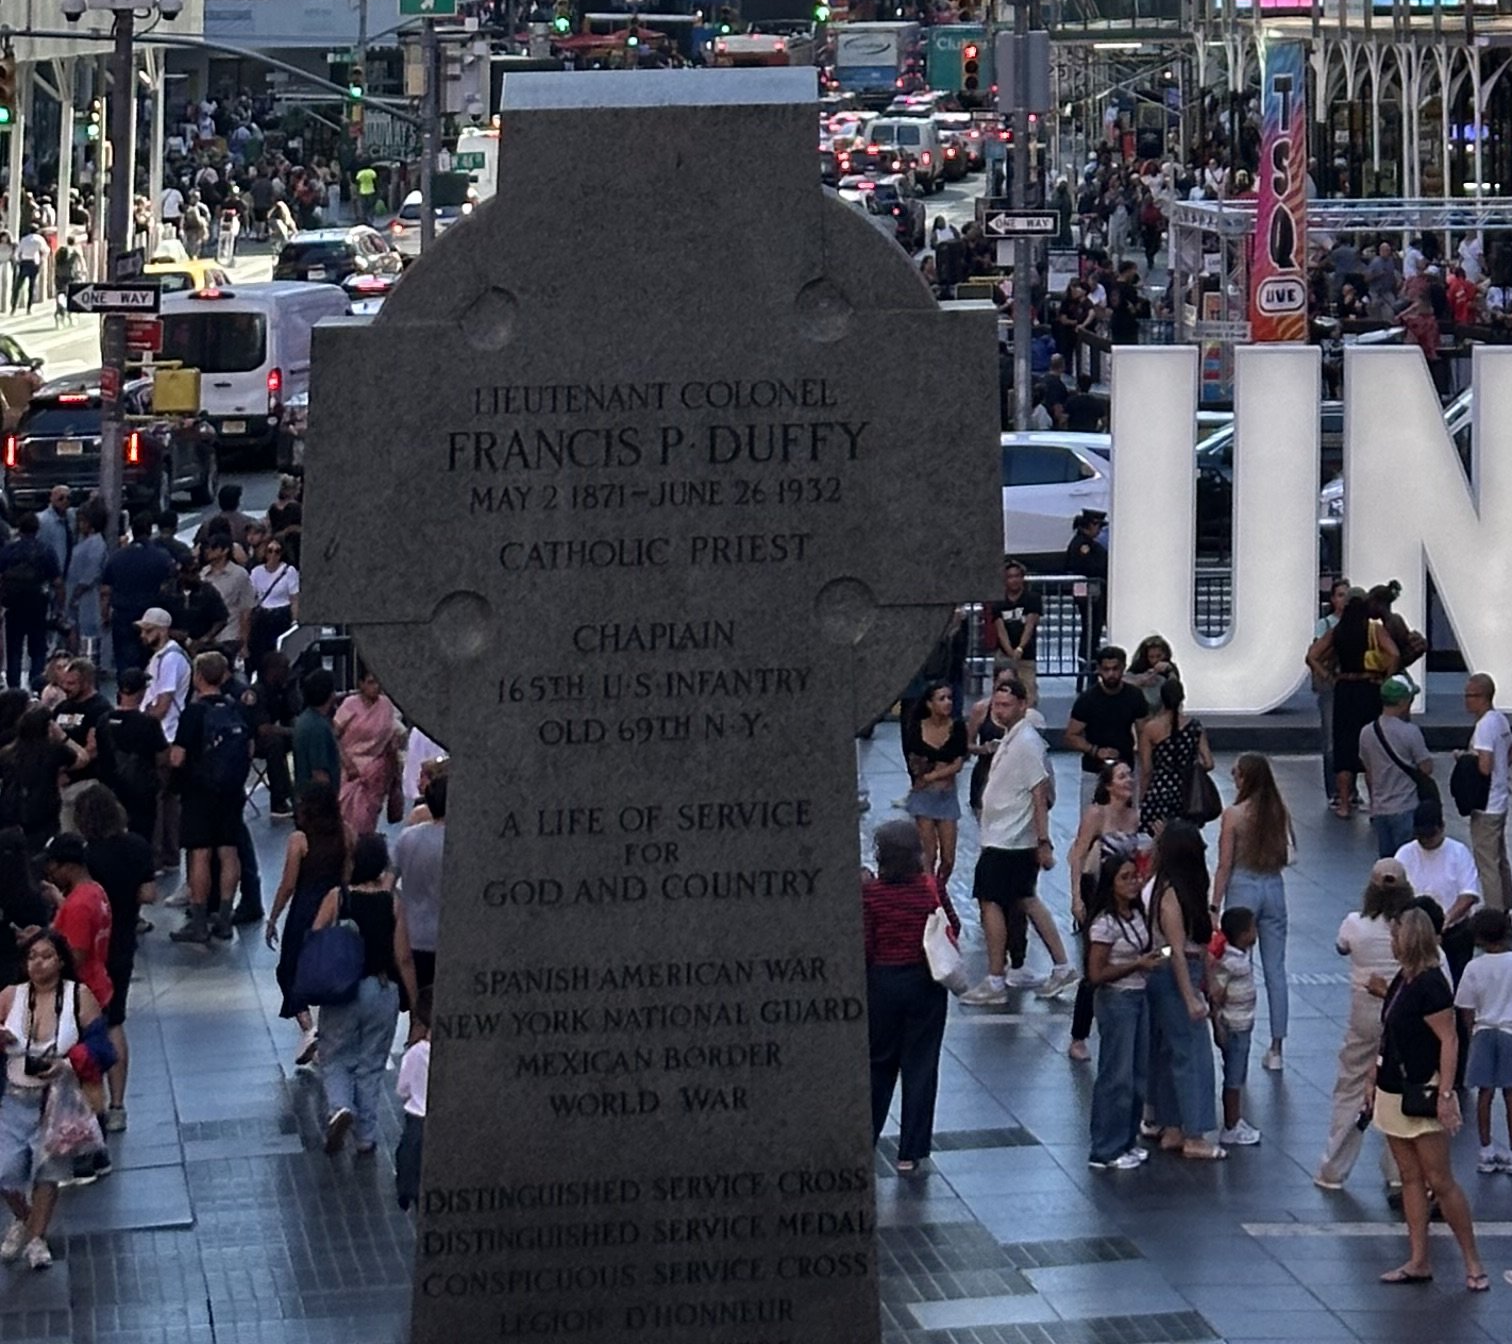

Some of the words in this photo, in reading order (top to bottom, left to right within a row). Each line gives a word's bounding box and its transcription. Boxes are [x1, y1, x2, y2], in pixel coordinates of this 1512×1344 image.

[1268, 72, 1300, 272] TSQ
[994, 217, 1016, 230] ONE
[1026, 216, 1050, 229] WAY
[81, 291, 108, 305] ONE
[120, 292, 149, 305] WAY
[1265, 288, 1297, 303] LIVE
[474, 381, 671, 415] LIEUTENANT
[680, 377, 838, 410] COLONEL
[447, 426, 642, 473] FRANCIS
[706, 420, 870, 465] DUFFY
[469, 486, 533, 514] MAY
[542, 484, 558, 511] 2
[734, 479, 767, 506] 26
[777, 476, 842, 504] 1932
[499, 537, 671, 571] CATHOLIC
[689, 533, 814, 564] PRIEST
[572, 619, 736, 655] CHAPLAIN
[497, 673, 585, 705] 165TH
[665, 666, 812, 700] INFANTRY
[537, 718, 606, 746] OLD
[617, 715, 692, 744] 69TH
[499, 811, 523, 839] A
[536, 806, 605, 837] LIFE
[618, 804, 663, 834] OF
[676, 798, 814, 832] SERVICE
[623, 840, 680, 866] FOR
[482, 878, 564, 908] GOD
[573, 874, 648, 903] AND
[660, 867, 823, 900] COUNTRY
[472, 965, 591, 996] SPANISH
[599, 958, 755, 992] AMERICAN
[763, 955, 828, 984] WAR
[433, 1012, 502, 1041] NEW
[510, 1007, 590, 1036] YORK
[602, 1001, 751, 1032] NATIONAL
[759, 996, 866, 1024] GUARD
[513, 1047, 654, 1079] MEXICAN
[663, 1041, 783, 1071] BORDER
[548, 1089, 661, 1119] WORLD
[679, 1085, 751, 1113] WAR
[423, 1177, 641, 1217] DISTINGUISHED
[651, 1171, 766, 1202] SERVICE
[777, 1166, 870, 1195] CROSS
[422, 1220, 641, 1258] DISTINGUISHED
[651, 1213, 765, 1243] SERVICE
[775, 1208, 875, 1238] MEDAL
[420, 1262, 638, 1298] CONSPICUOUS
[651, 1256, 766, 1287] SERVICE
[775, 1251, 870, 1280] CROSS
